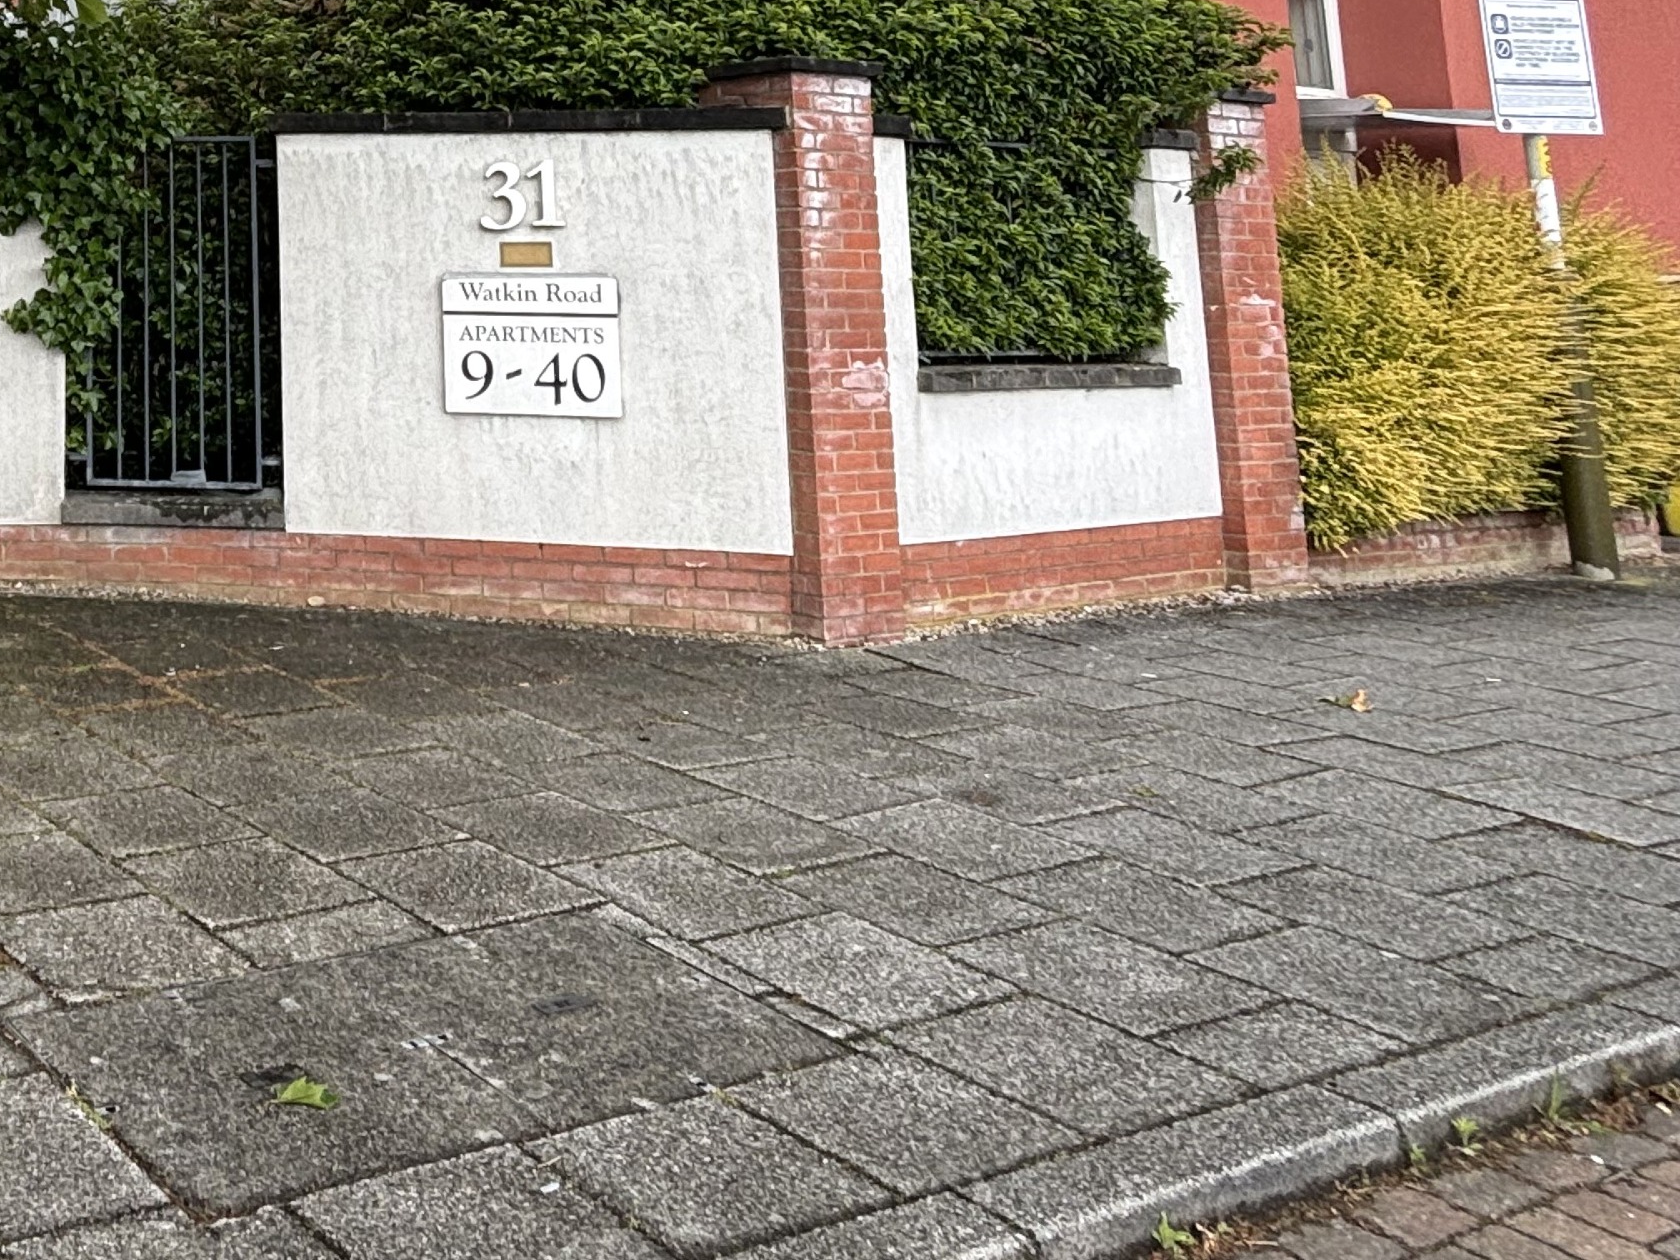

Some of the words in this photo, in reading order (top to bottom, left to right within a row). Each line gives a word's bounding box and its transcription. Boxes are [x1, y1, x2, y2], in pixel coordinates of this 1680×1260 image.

[480, 159, 567, 231] 31
[458, 282, 538, 302] Watkin
[545, 283, 602, 303] Road
[458, 325, 605, 345] APARTMENTS
